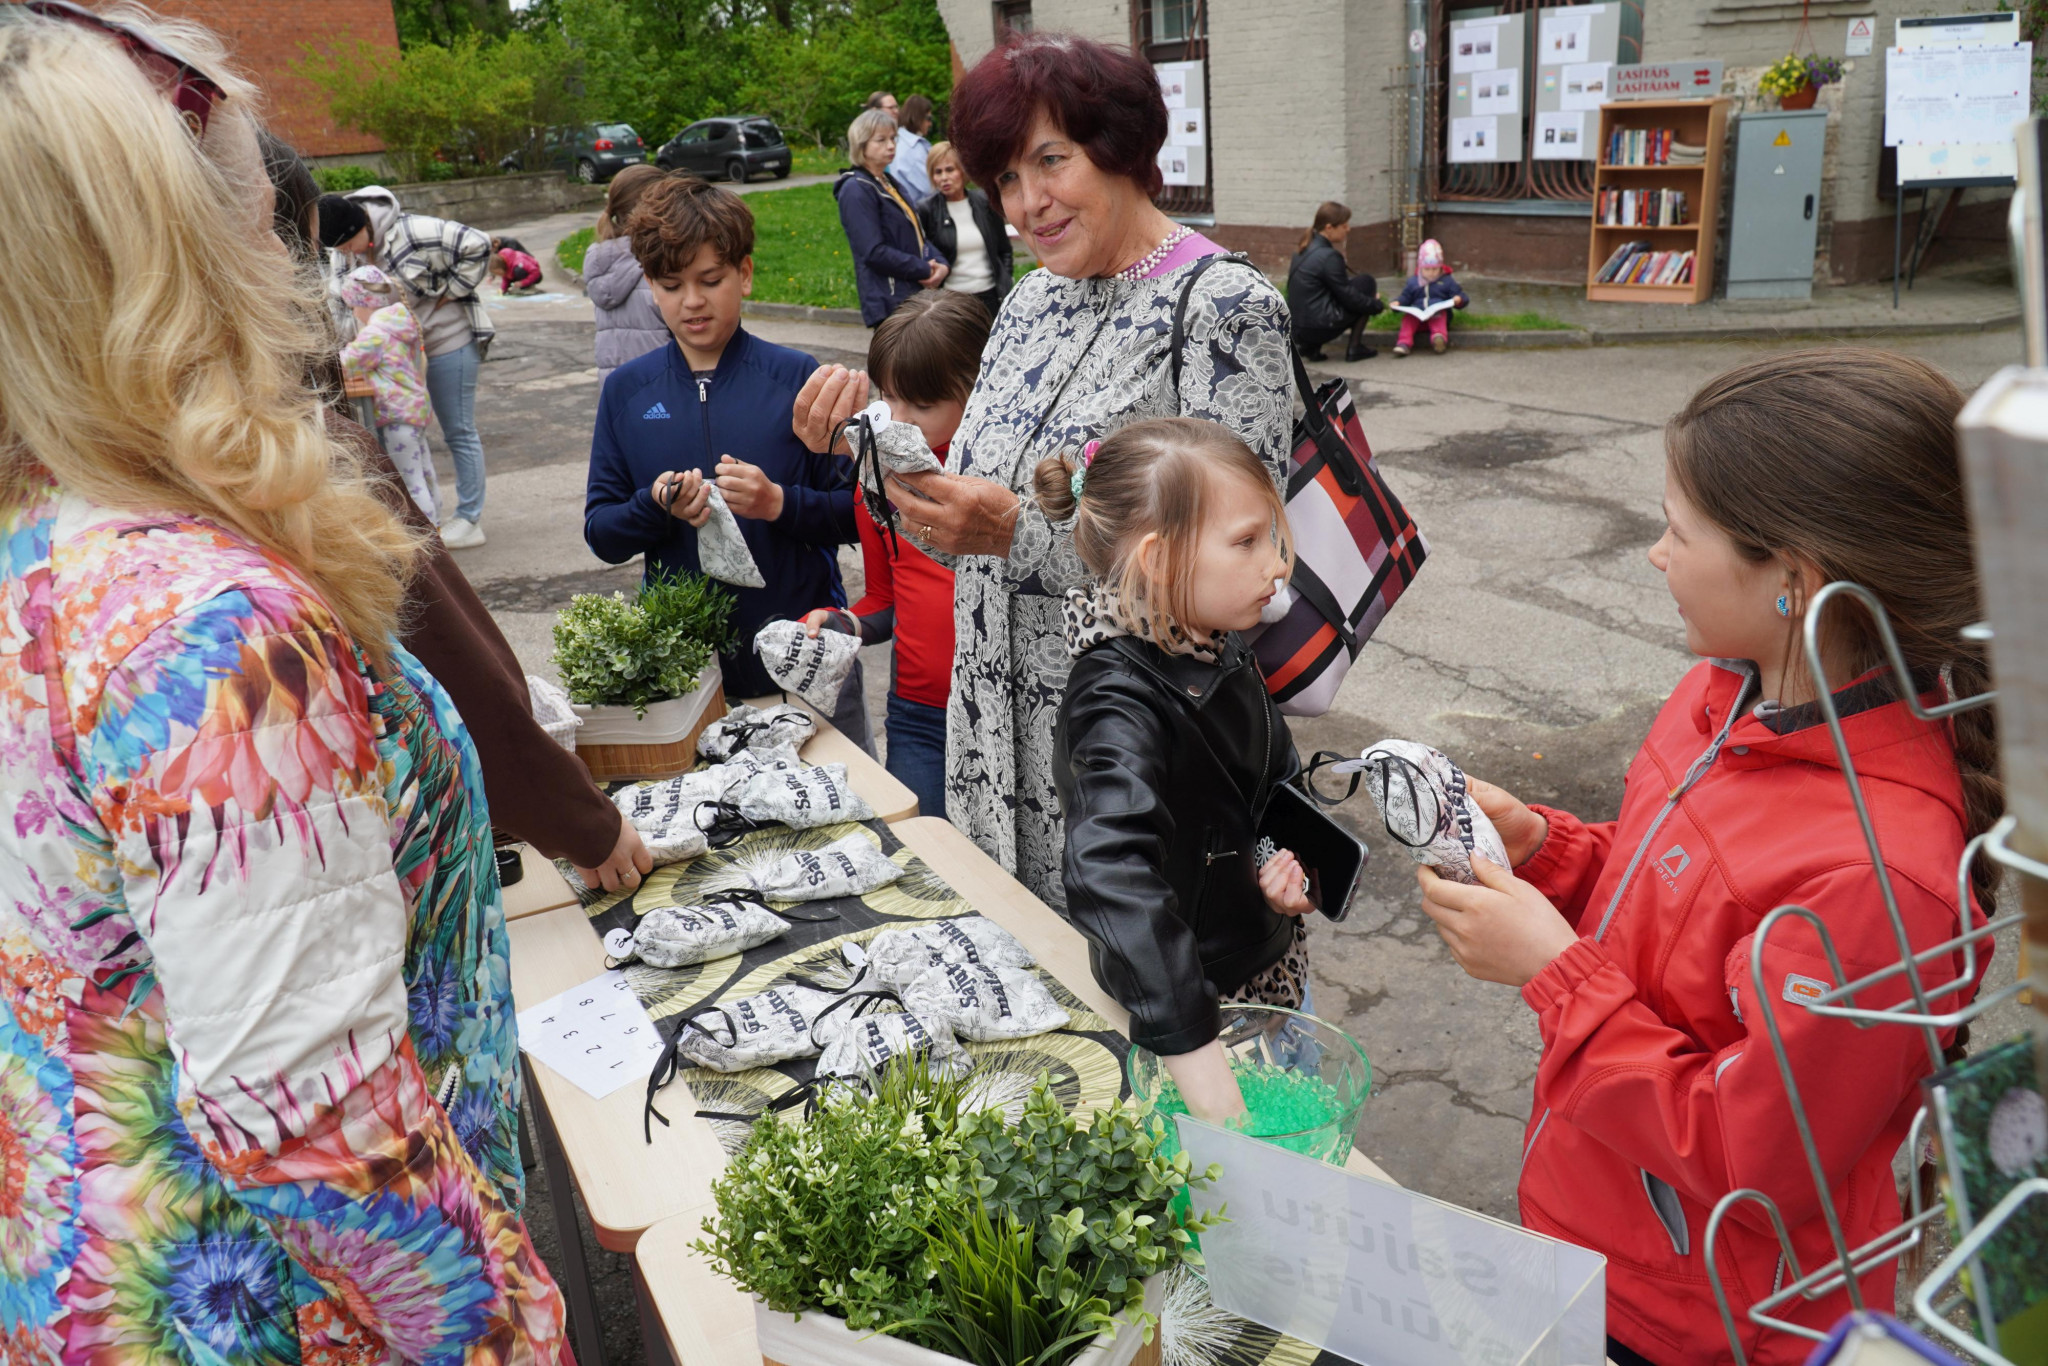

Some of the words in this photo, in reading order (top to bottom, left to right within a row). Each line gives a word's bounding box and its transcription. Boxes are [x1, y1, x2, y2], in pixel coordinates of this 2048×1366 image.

[643, 412, 671, 420] adidas
[874, 412, 881, 422] 6
[793, 851, 827, 887] Sajū
[613, 937, 626, 949] 10
[1792, 982, 1822, 999] ICE
[579, 998, 594, 1007] 8
[541, 1016, 555, 1024] 4
[600, 1013, 616, 1021] 7
[562, 1030, 579, 1040] 3
[623, 1026, 639, 1035] 6
[585, 1044, 602, 1055] 2
[609, 1060, 624, 1069] 1
